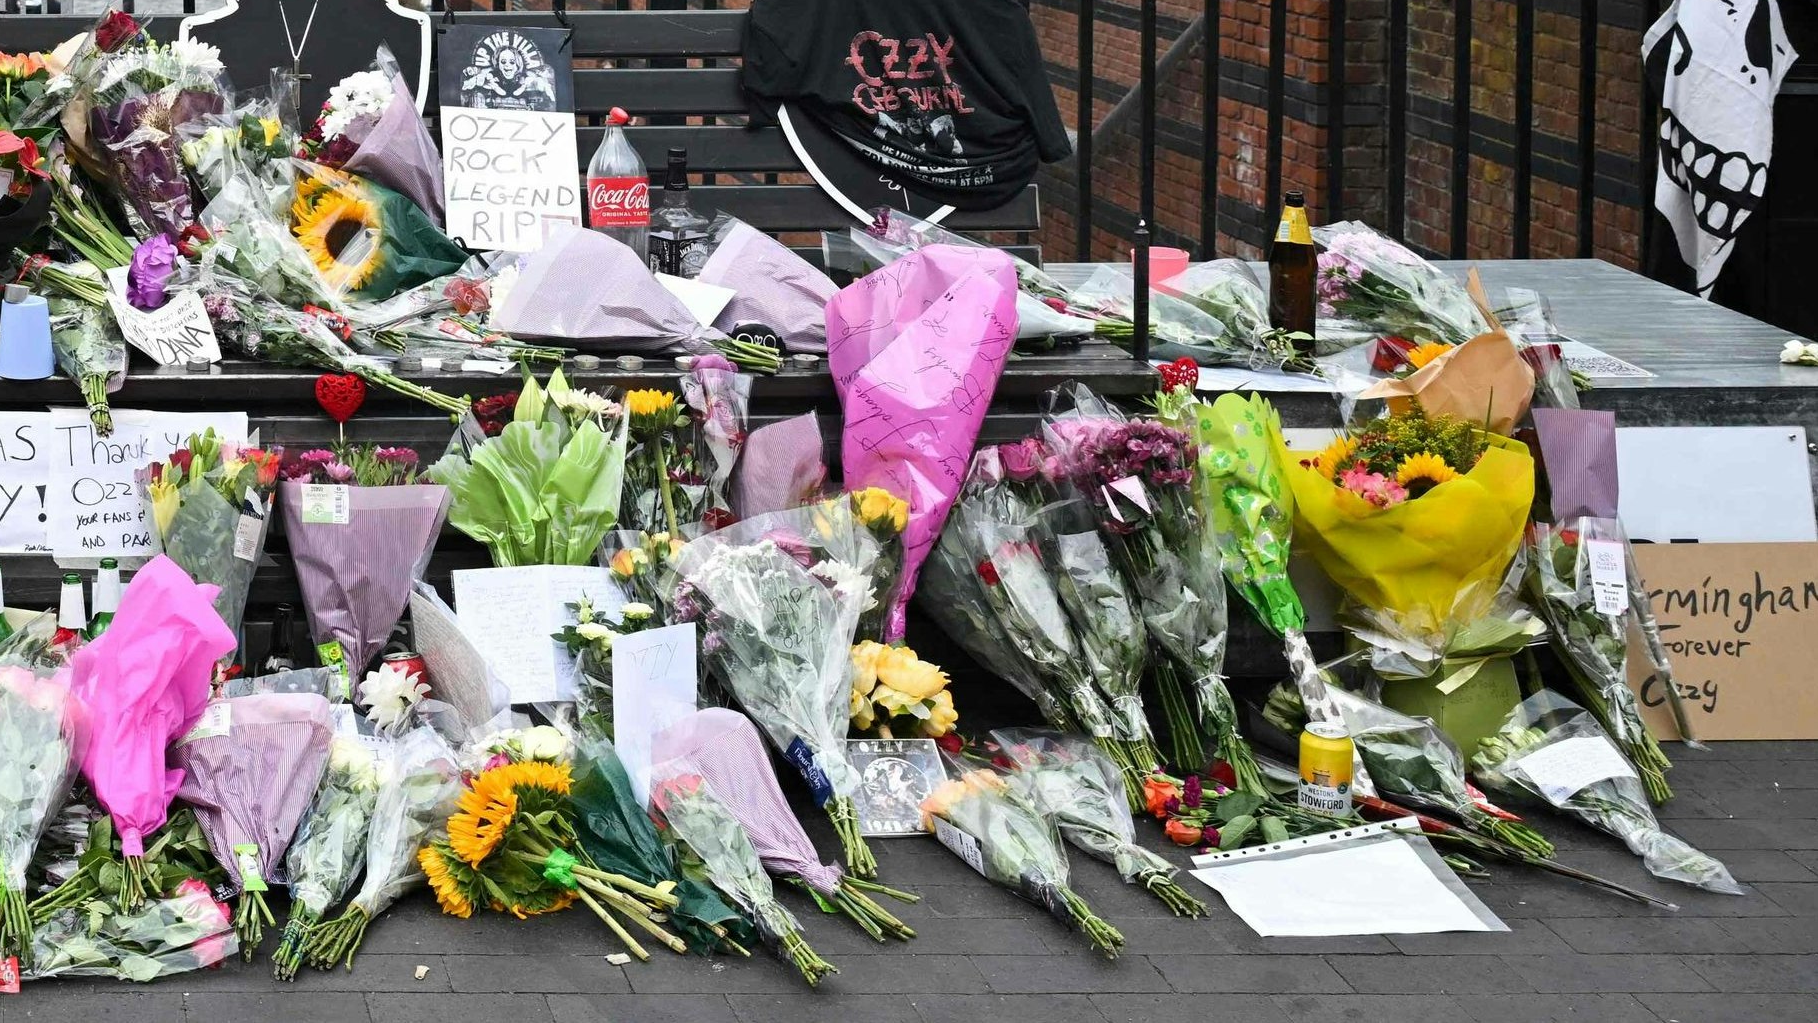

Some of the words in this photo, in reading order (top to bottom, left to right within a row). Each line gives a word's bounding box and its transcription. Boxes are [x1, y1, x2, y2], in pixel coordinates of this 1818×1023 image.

[475, 48, 491, 67] UP
[484, 32, 510, 52] THE
[513, 34, 541, 69] VILLA
[846, 31, 956, 87] OZZY
[852, 82, 975, 116] OSBOURNE
[449, 114, 566, 146] OZZY
[450, 147, 547, 174] ROCK
[449, 178, 575, 207] LEGEND
[472, 211, 536, 243] RIP
[156, 326, 210, 365] DANA
[55, 424, 153, 466] Thank
[76, 514, 99, 530] YOUR
[103, 511, 132, 524] FANS
[82, 536, 106, 548] AND
[122, 533, 151, 548] PAR
[1641, 571, 1818, 634] rmingha
[1300, 791, 1344, 810] STOWFORD
[1308, 787, 1334, 797] WESTONS
